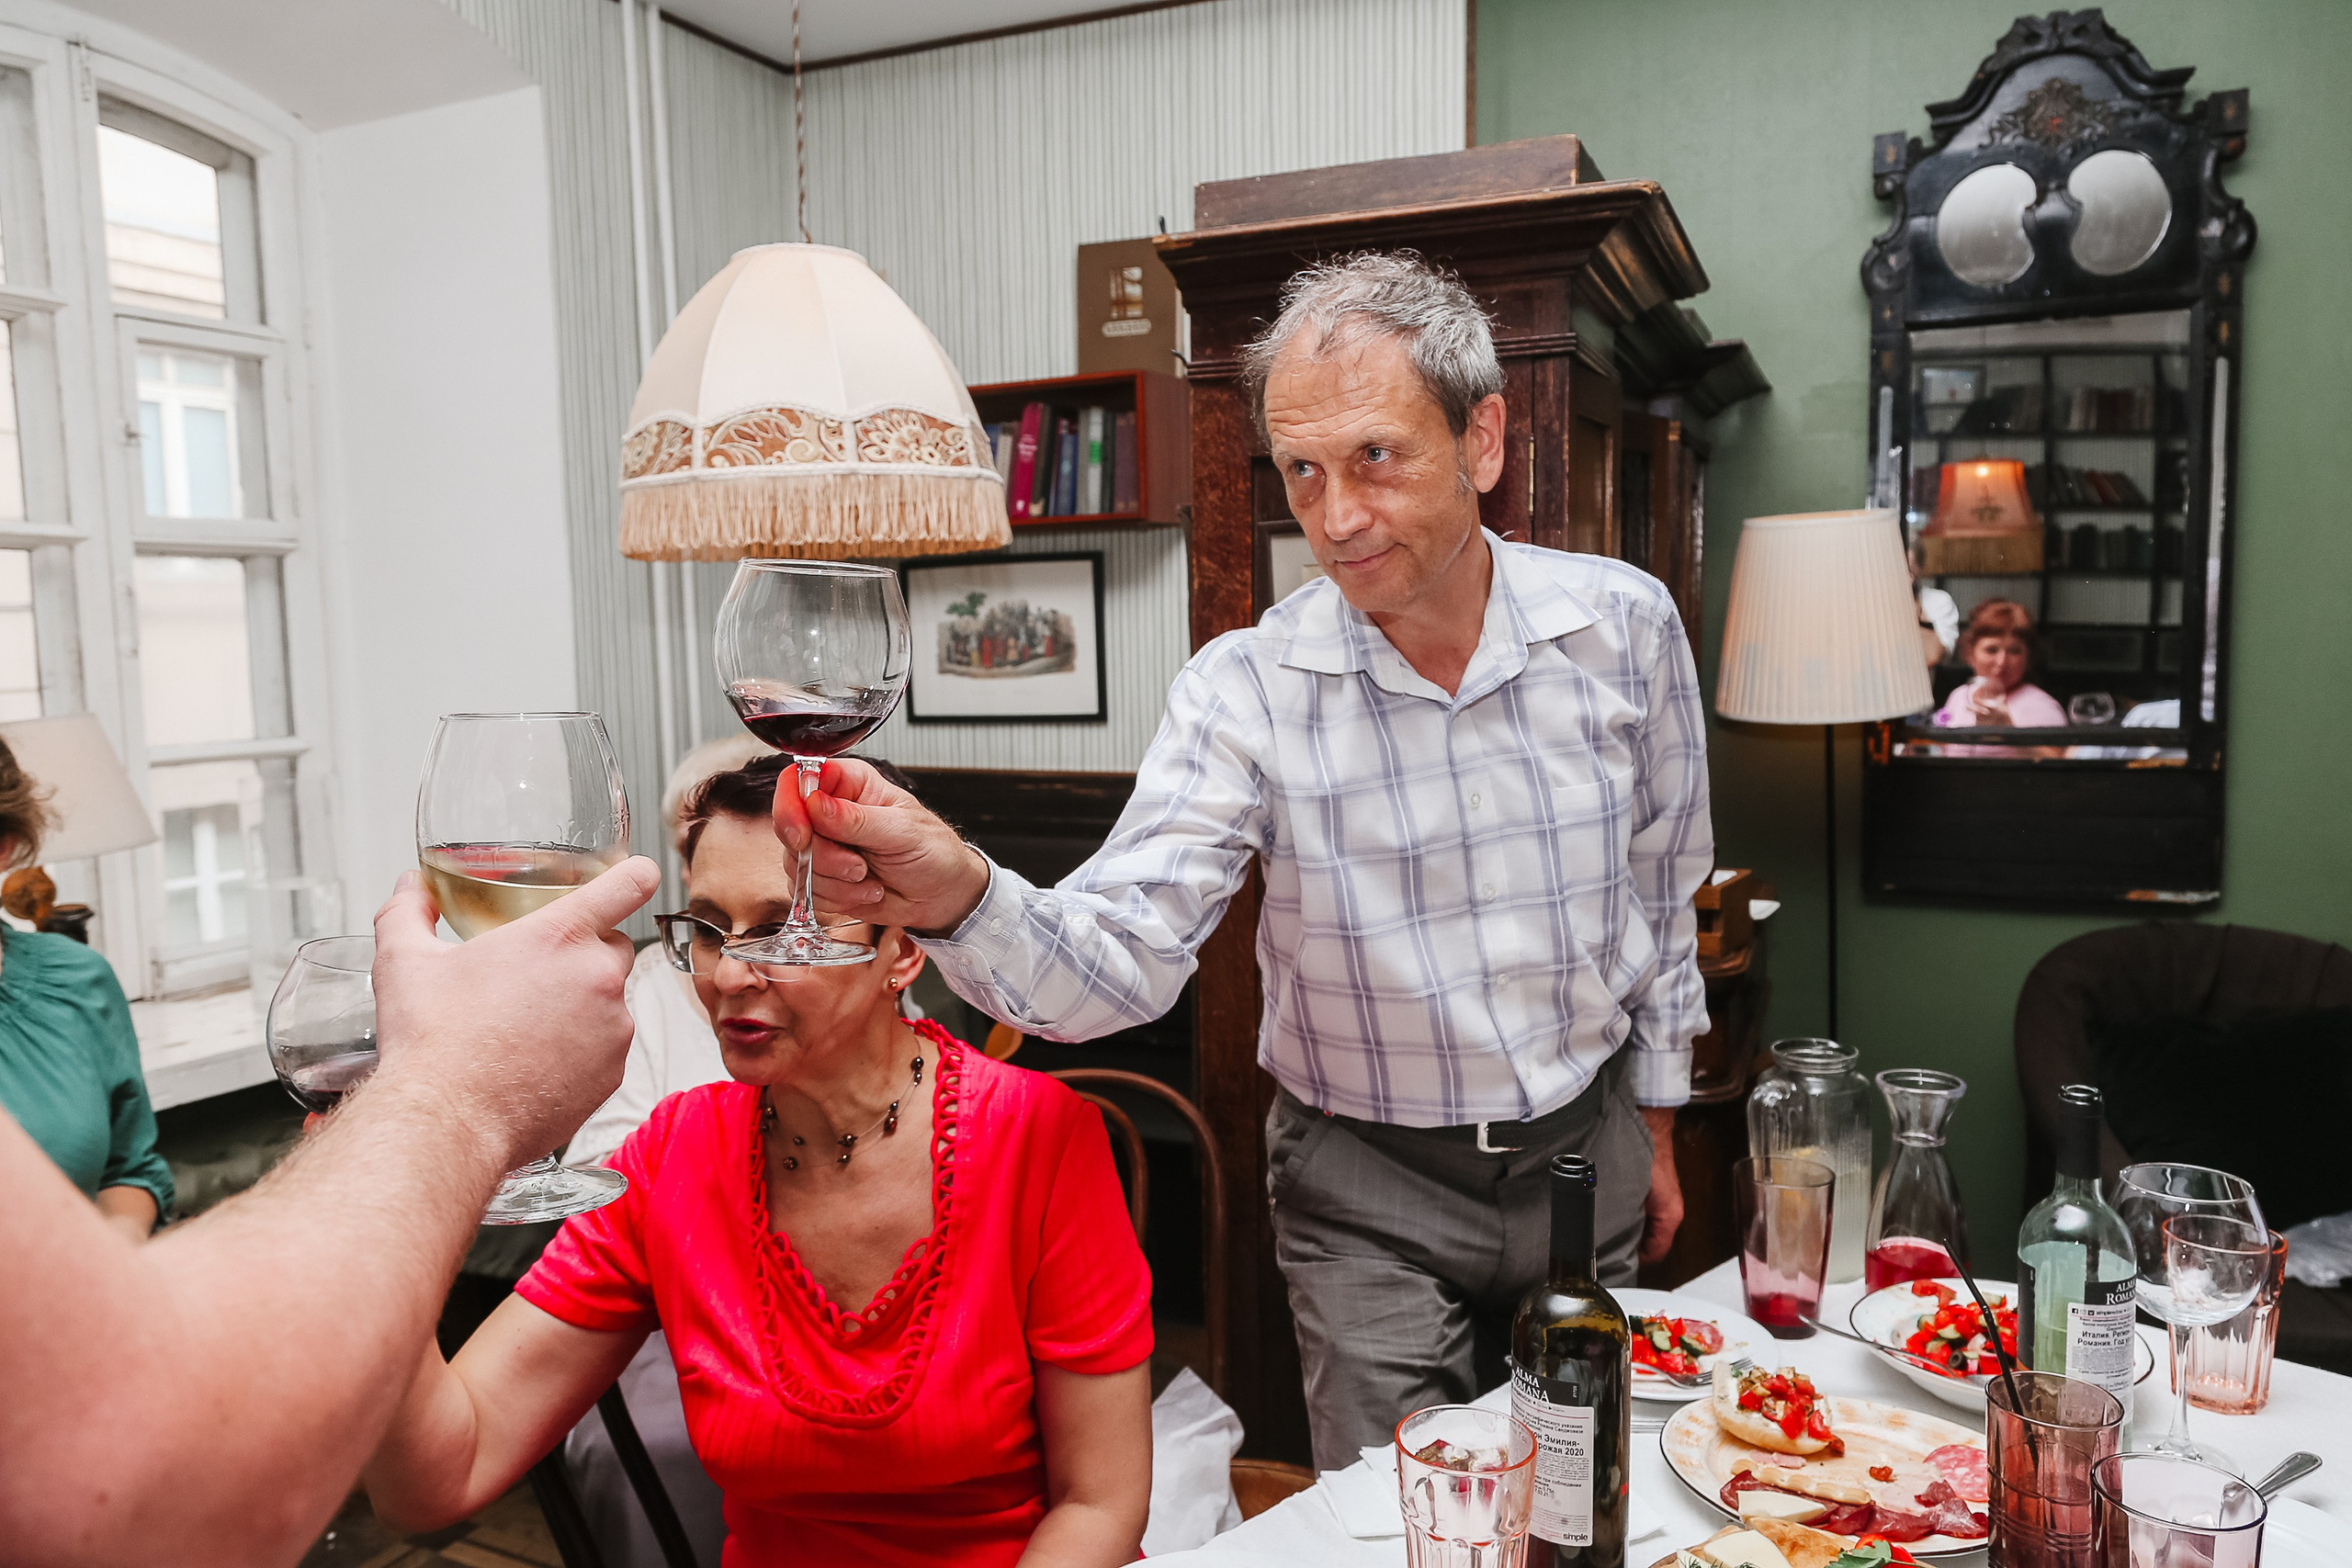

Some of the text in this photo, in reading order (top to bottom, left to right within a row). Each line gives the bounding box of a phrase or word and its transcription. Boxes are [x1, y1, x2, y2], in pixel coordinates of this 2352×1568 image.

[1515, 1366, 1540, 1388] ALMA
[1544, 1434, 1580, 1447] Эмилия-
[1538, 1442, 1584, 1457] рожая 2020
[1563, 1533, 1589, 1542] simple
